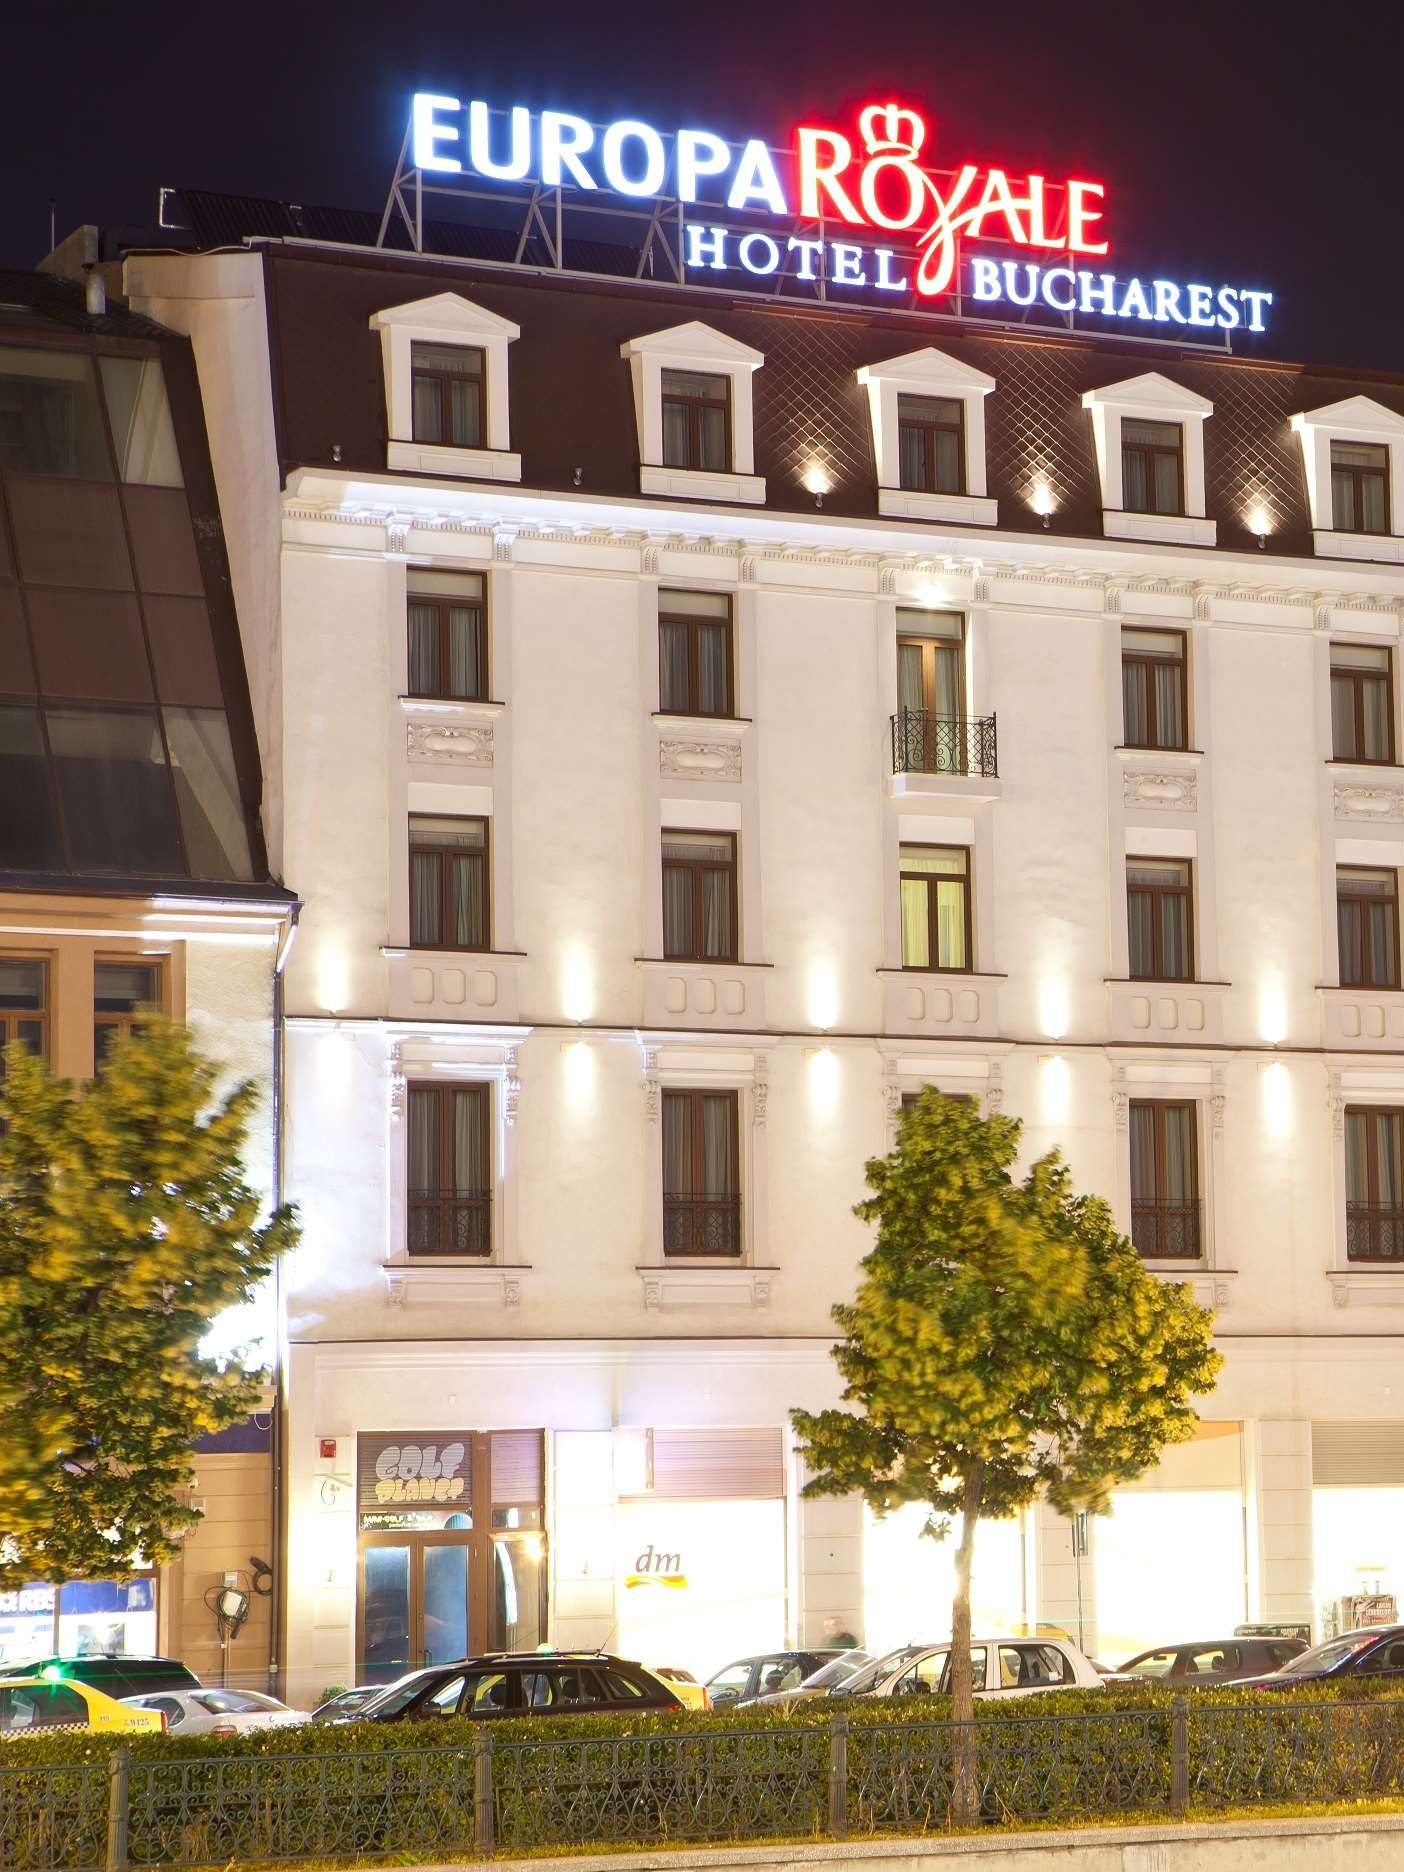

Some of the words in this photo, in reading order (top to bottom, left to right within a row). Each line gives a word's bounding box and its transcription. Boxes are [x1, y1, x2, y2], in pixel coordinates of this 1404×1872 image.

[412, 92, 789, 216] EUROPA
[685, 224, 908, 292] HOTEL
[970, 257, 1274, 333] BUCHAREST
[375, 1442, 465, 1480] GOLF
[375, 1477, 465, 1504] PLANET
[635, 1544, 681, 1573] dm
